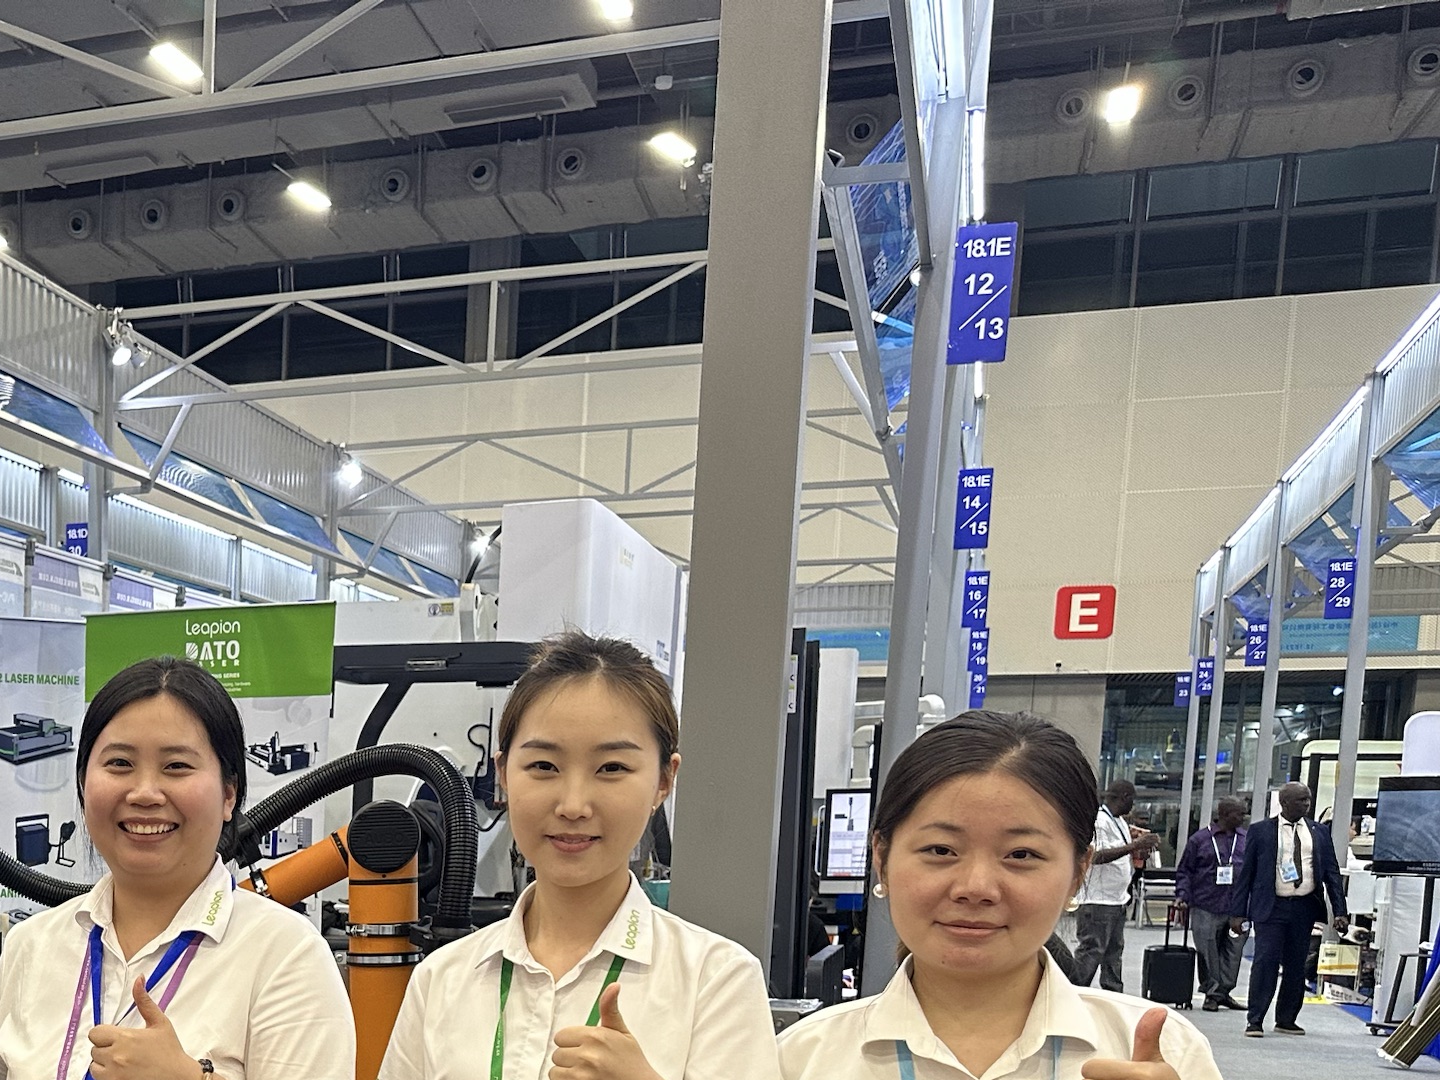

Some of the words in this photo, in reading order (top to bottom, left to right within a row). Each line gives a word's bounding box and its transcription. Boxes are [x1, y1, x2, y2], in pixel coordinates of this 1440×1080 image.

[962, 236, 1012, 259] 18.1E
[963, 273, 994, 296] 12
[974, 317, 1005, 340] 13
[961, 474, 992, 488] 18.1E
[961, 496, 981, 509] 14
[969, 521, 988, 535] 15
[1329, 561, 1353, 572] 18.1E
[967, 576, 989, 586] 18.1E
[1330, 577, 1346, 588] 28
[968, 590, 982, 601] 16
[1335, 596, 1351, 608] 29
[972, 608, 986, 620] 17
[1068, 592, 1100, 633] E
[186, 619, 241, 638] Leapion
[1249, 623, 1267, 633] 18.1E
[1249, 635, 1262, 645] 26
[185, 640, 241, 660] DATO
[971, 642, 983, 651] 18
[1253, 650, 1266, 660] 27
[975, 656, 986, 666] 19
[5, 673, 35, 684] LASER
[36, 674, 80, 686] MACHINE
[973, 674, 983, 682] 20
[1198, 670, 1209, 679] 24
[976, 686, 985, 694] 21
[1201, 682, 1212, 691] 25
[1178, 689, 1188, 697] 23
[202, 890, 224, 927] Leapion
[621, 909, 640, 951] Leapion
